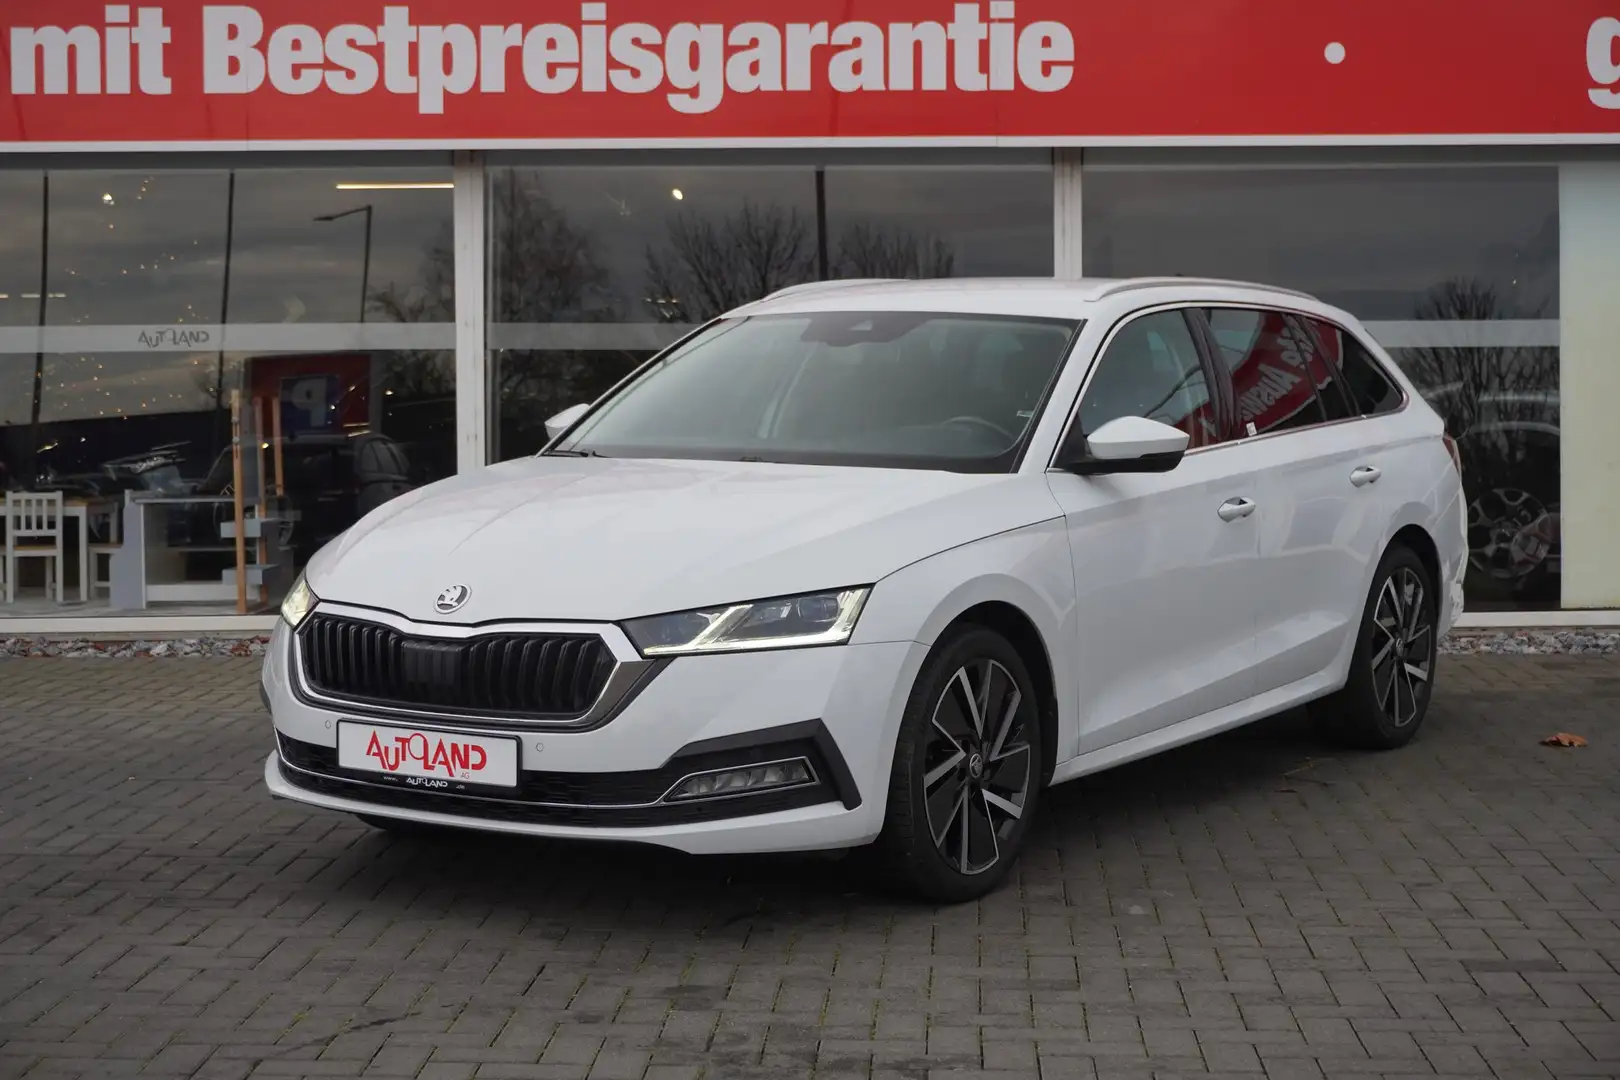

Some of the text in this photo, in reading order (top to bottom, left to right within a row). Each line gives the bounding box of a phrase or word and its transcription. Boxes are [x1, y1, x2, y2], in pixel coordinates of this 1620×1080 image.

[10, 1, 1075, 114] mit Bestpreisgarantie
[138, 328, 210, 348] AUTOLAND
[366, 729, 487, 777] AUTOLAND
[406, 776, 448, 788] AUTOLAND
